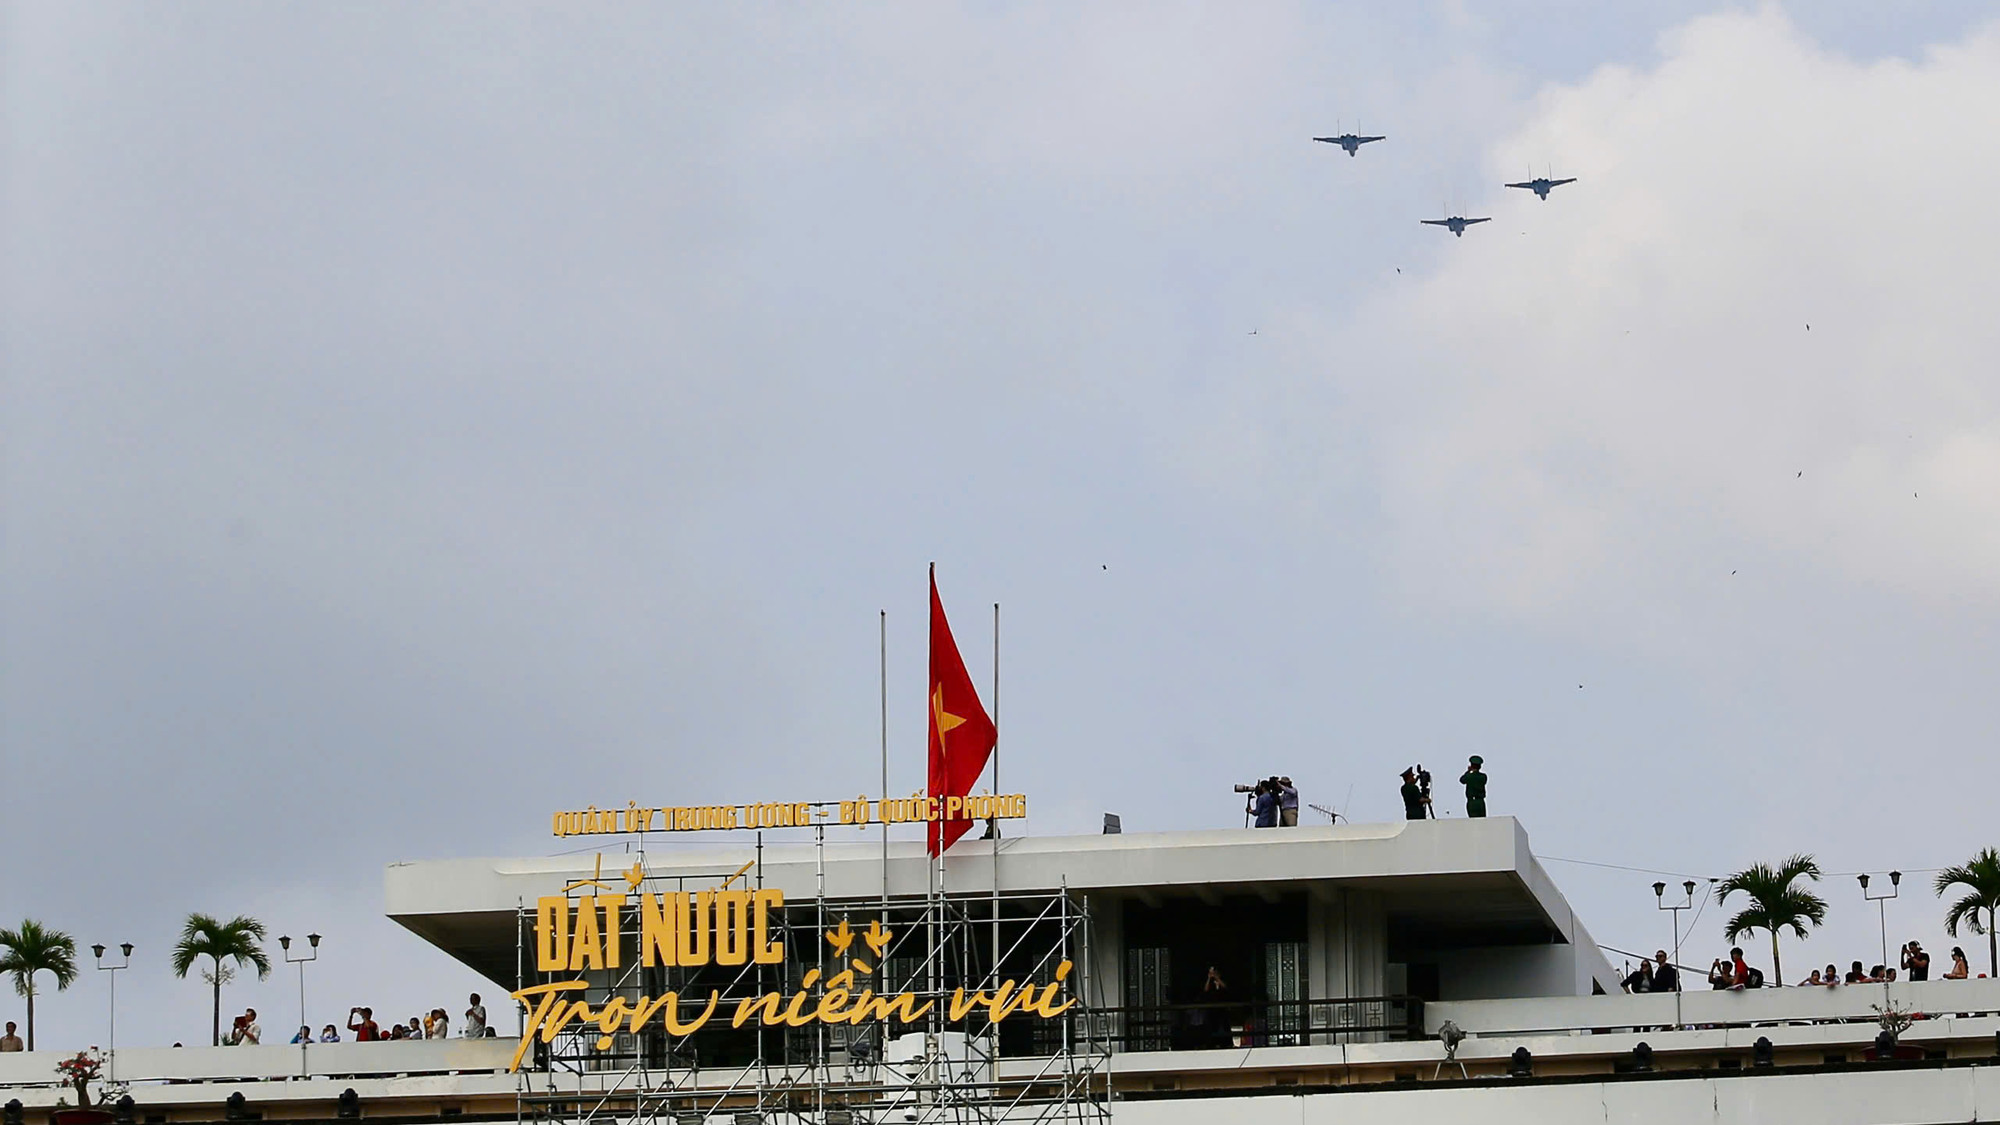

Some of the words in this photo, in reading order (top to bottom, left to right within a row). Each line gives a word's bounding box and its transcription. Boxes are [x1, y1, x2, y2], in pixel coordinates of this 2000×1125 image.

[553, 805, 617, 838] QUÂN
[662, 805, 737, 831] TRUNG
[744, 801, 810, 829] ƯƠNG
[839, 794, 870, 830] BỘ
[878, 788, 939, 826] QUỐC
[946, 788, 1026, 821] PHÒNG
[533, 852, 628, 973] ĐẤT
[641, 860, 785, 968] NƯỚC
[509, 979, 719, 1074] Trọn
[732, 958, 935, 1029] niềm
[949, 960, 1076, 1024] vui
